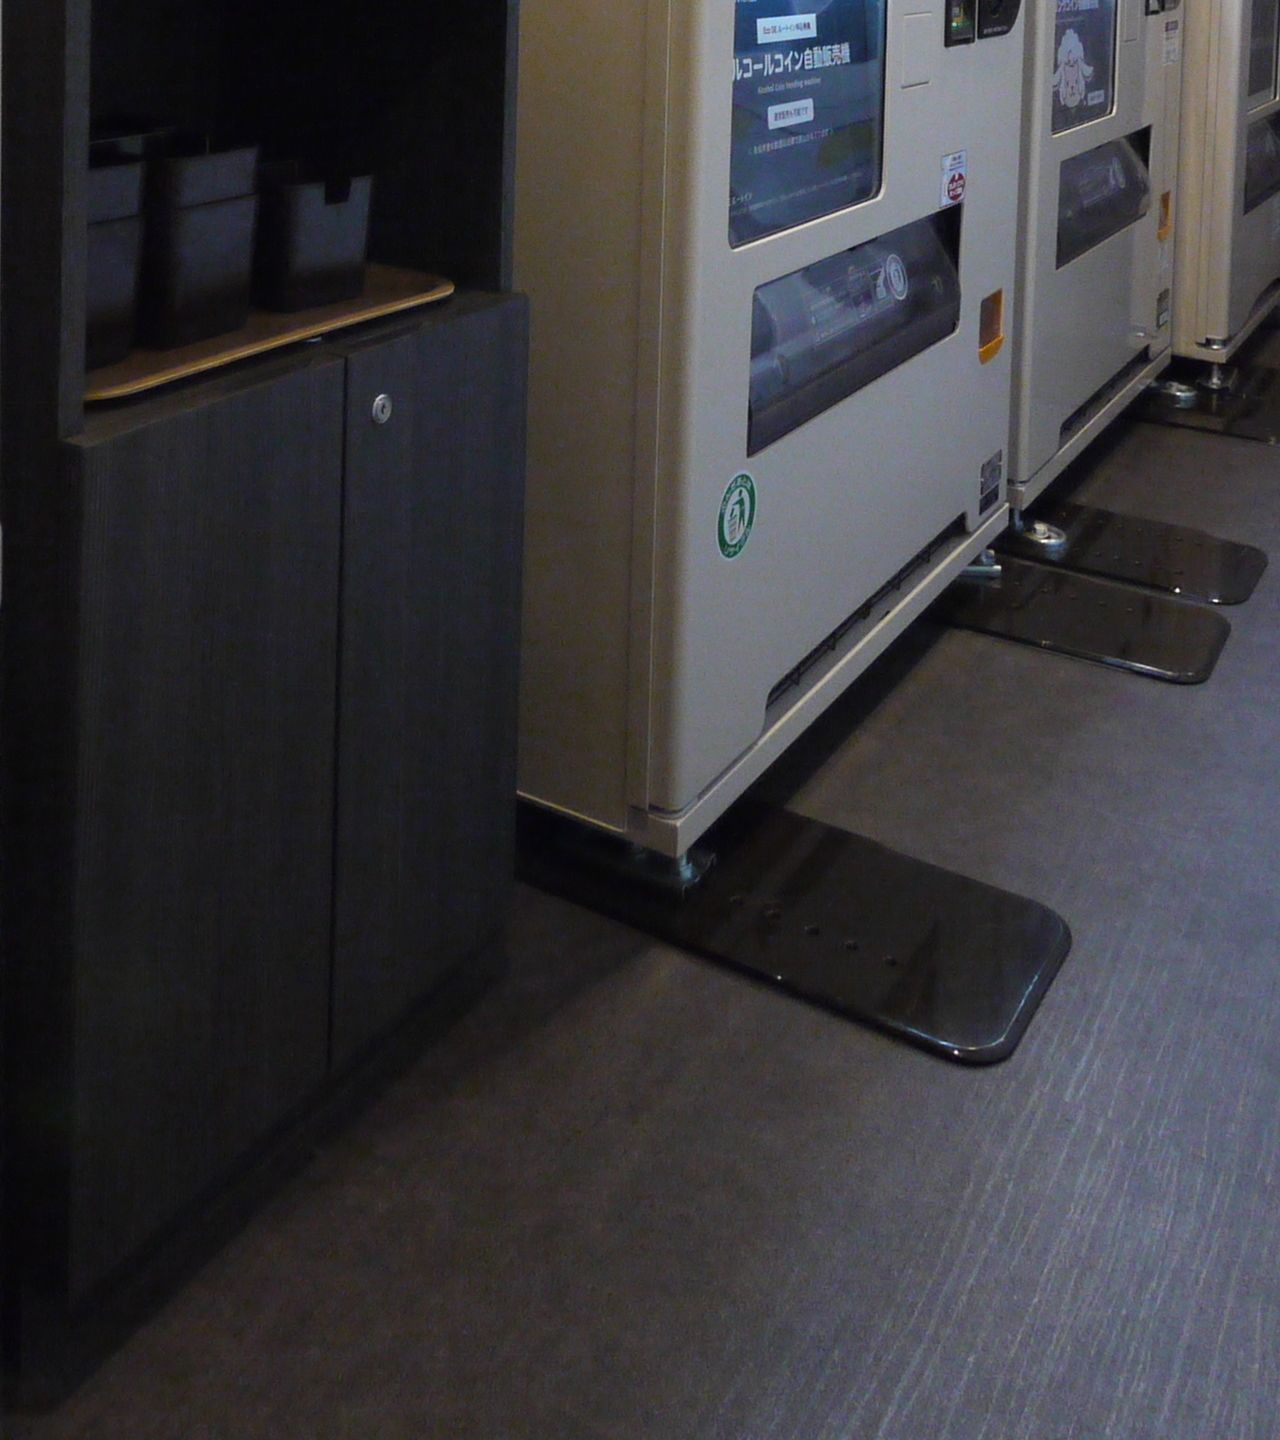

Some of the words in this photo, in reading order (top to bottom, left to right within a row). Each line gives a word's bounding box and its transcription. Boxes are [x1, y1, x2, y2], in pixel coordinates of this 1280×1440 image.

[732, 42, 851, 81] ルコールコイン自動販売機
